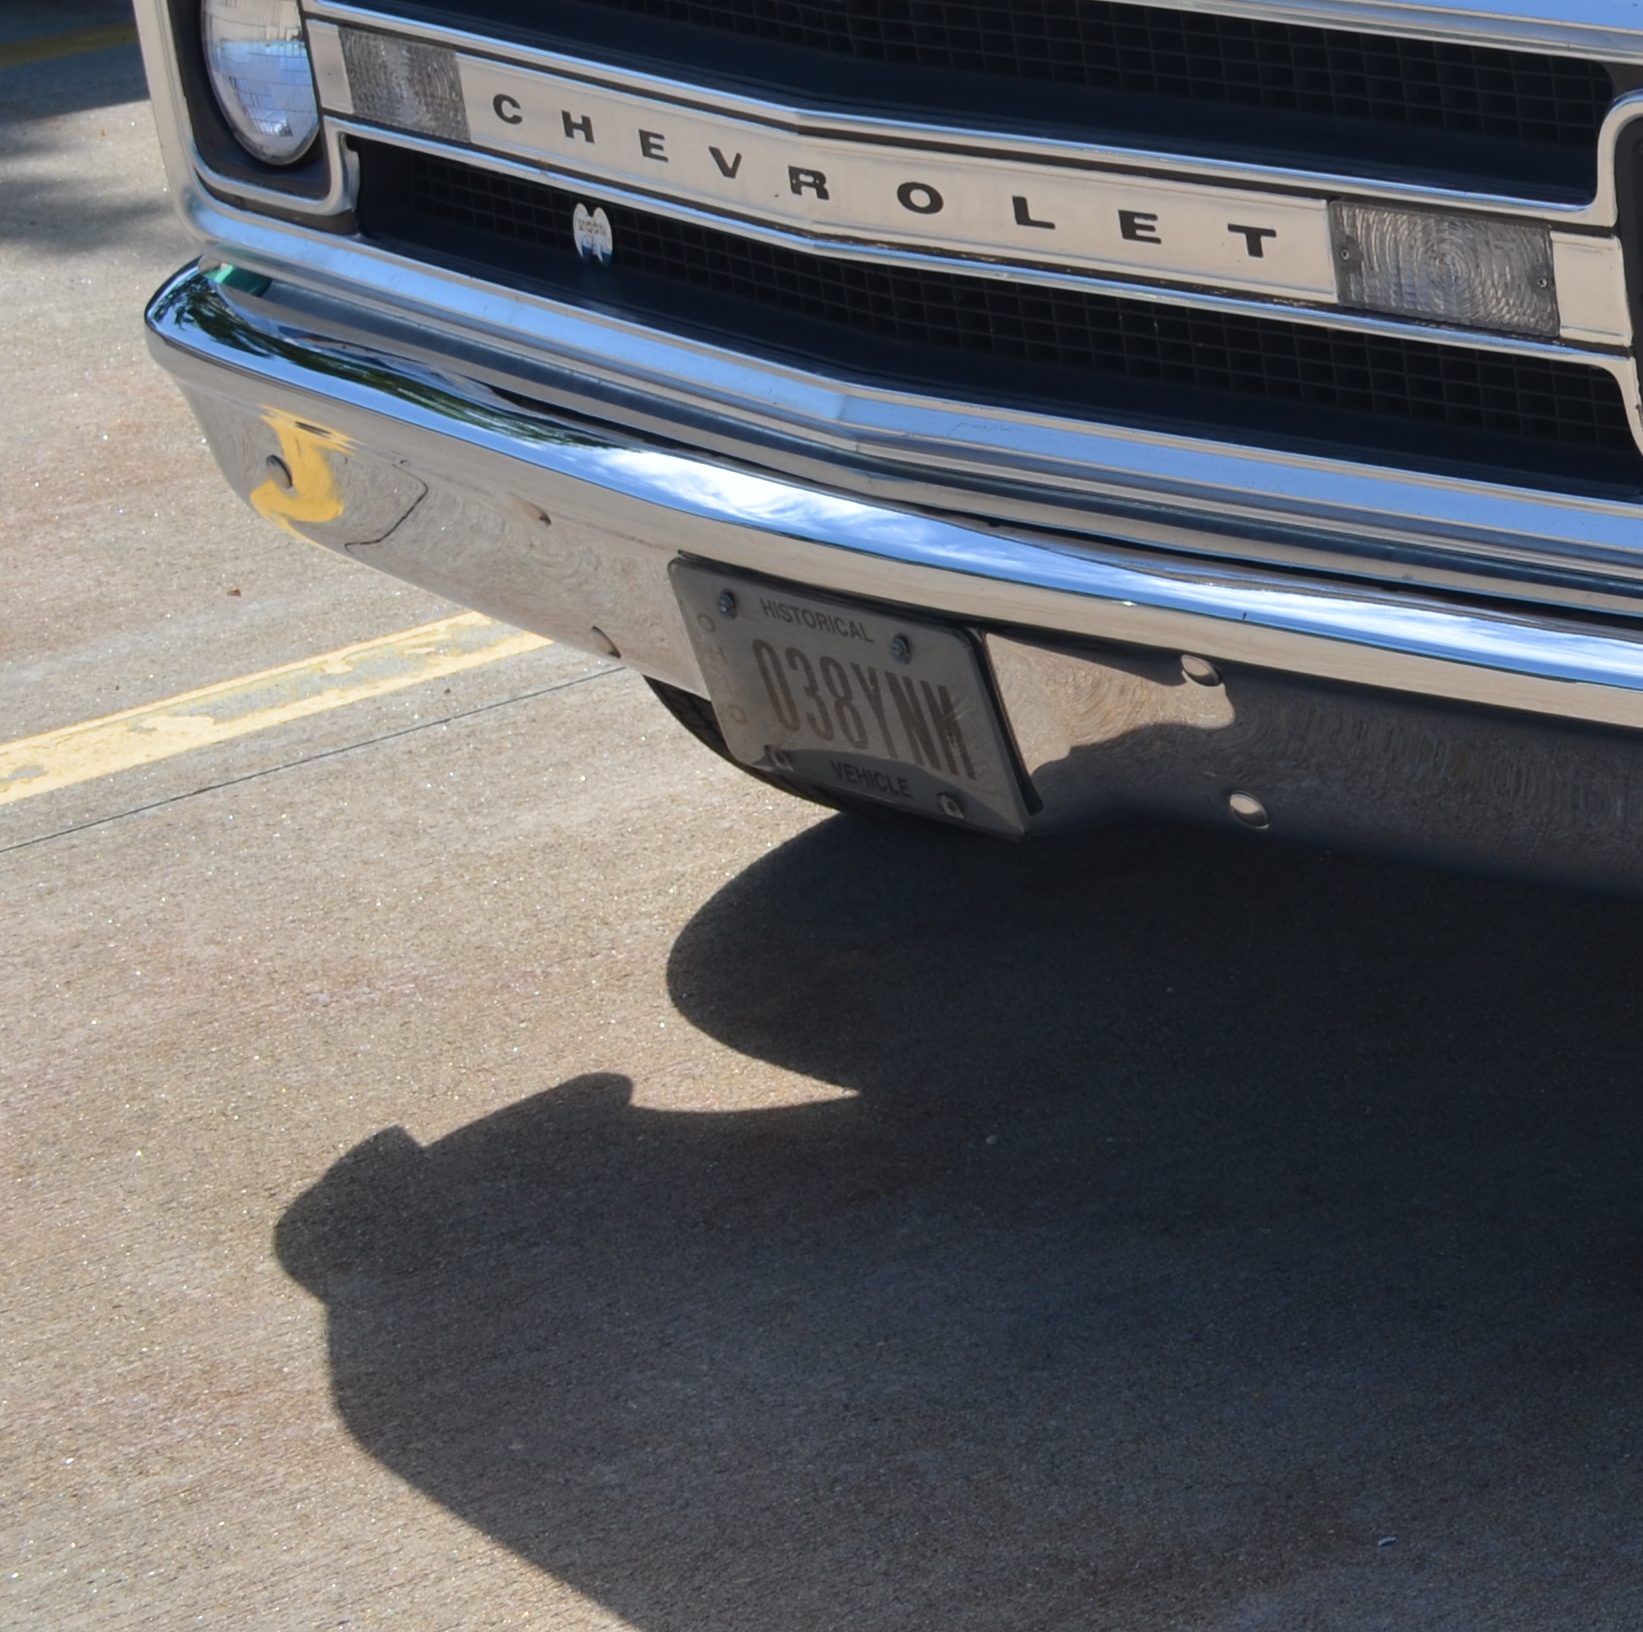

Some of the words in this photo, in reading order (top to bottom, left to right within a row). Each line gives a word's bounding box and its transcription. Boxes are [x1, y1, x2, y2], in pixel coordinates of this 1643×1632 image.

[491, 93, 1277, 259] CHEVROLET
[760, 597, 876, 644] HISTORICAL
[752, 639, 978, 781] 038YNM
[829, 759, 913, 799] VEHICLE
